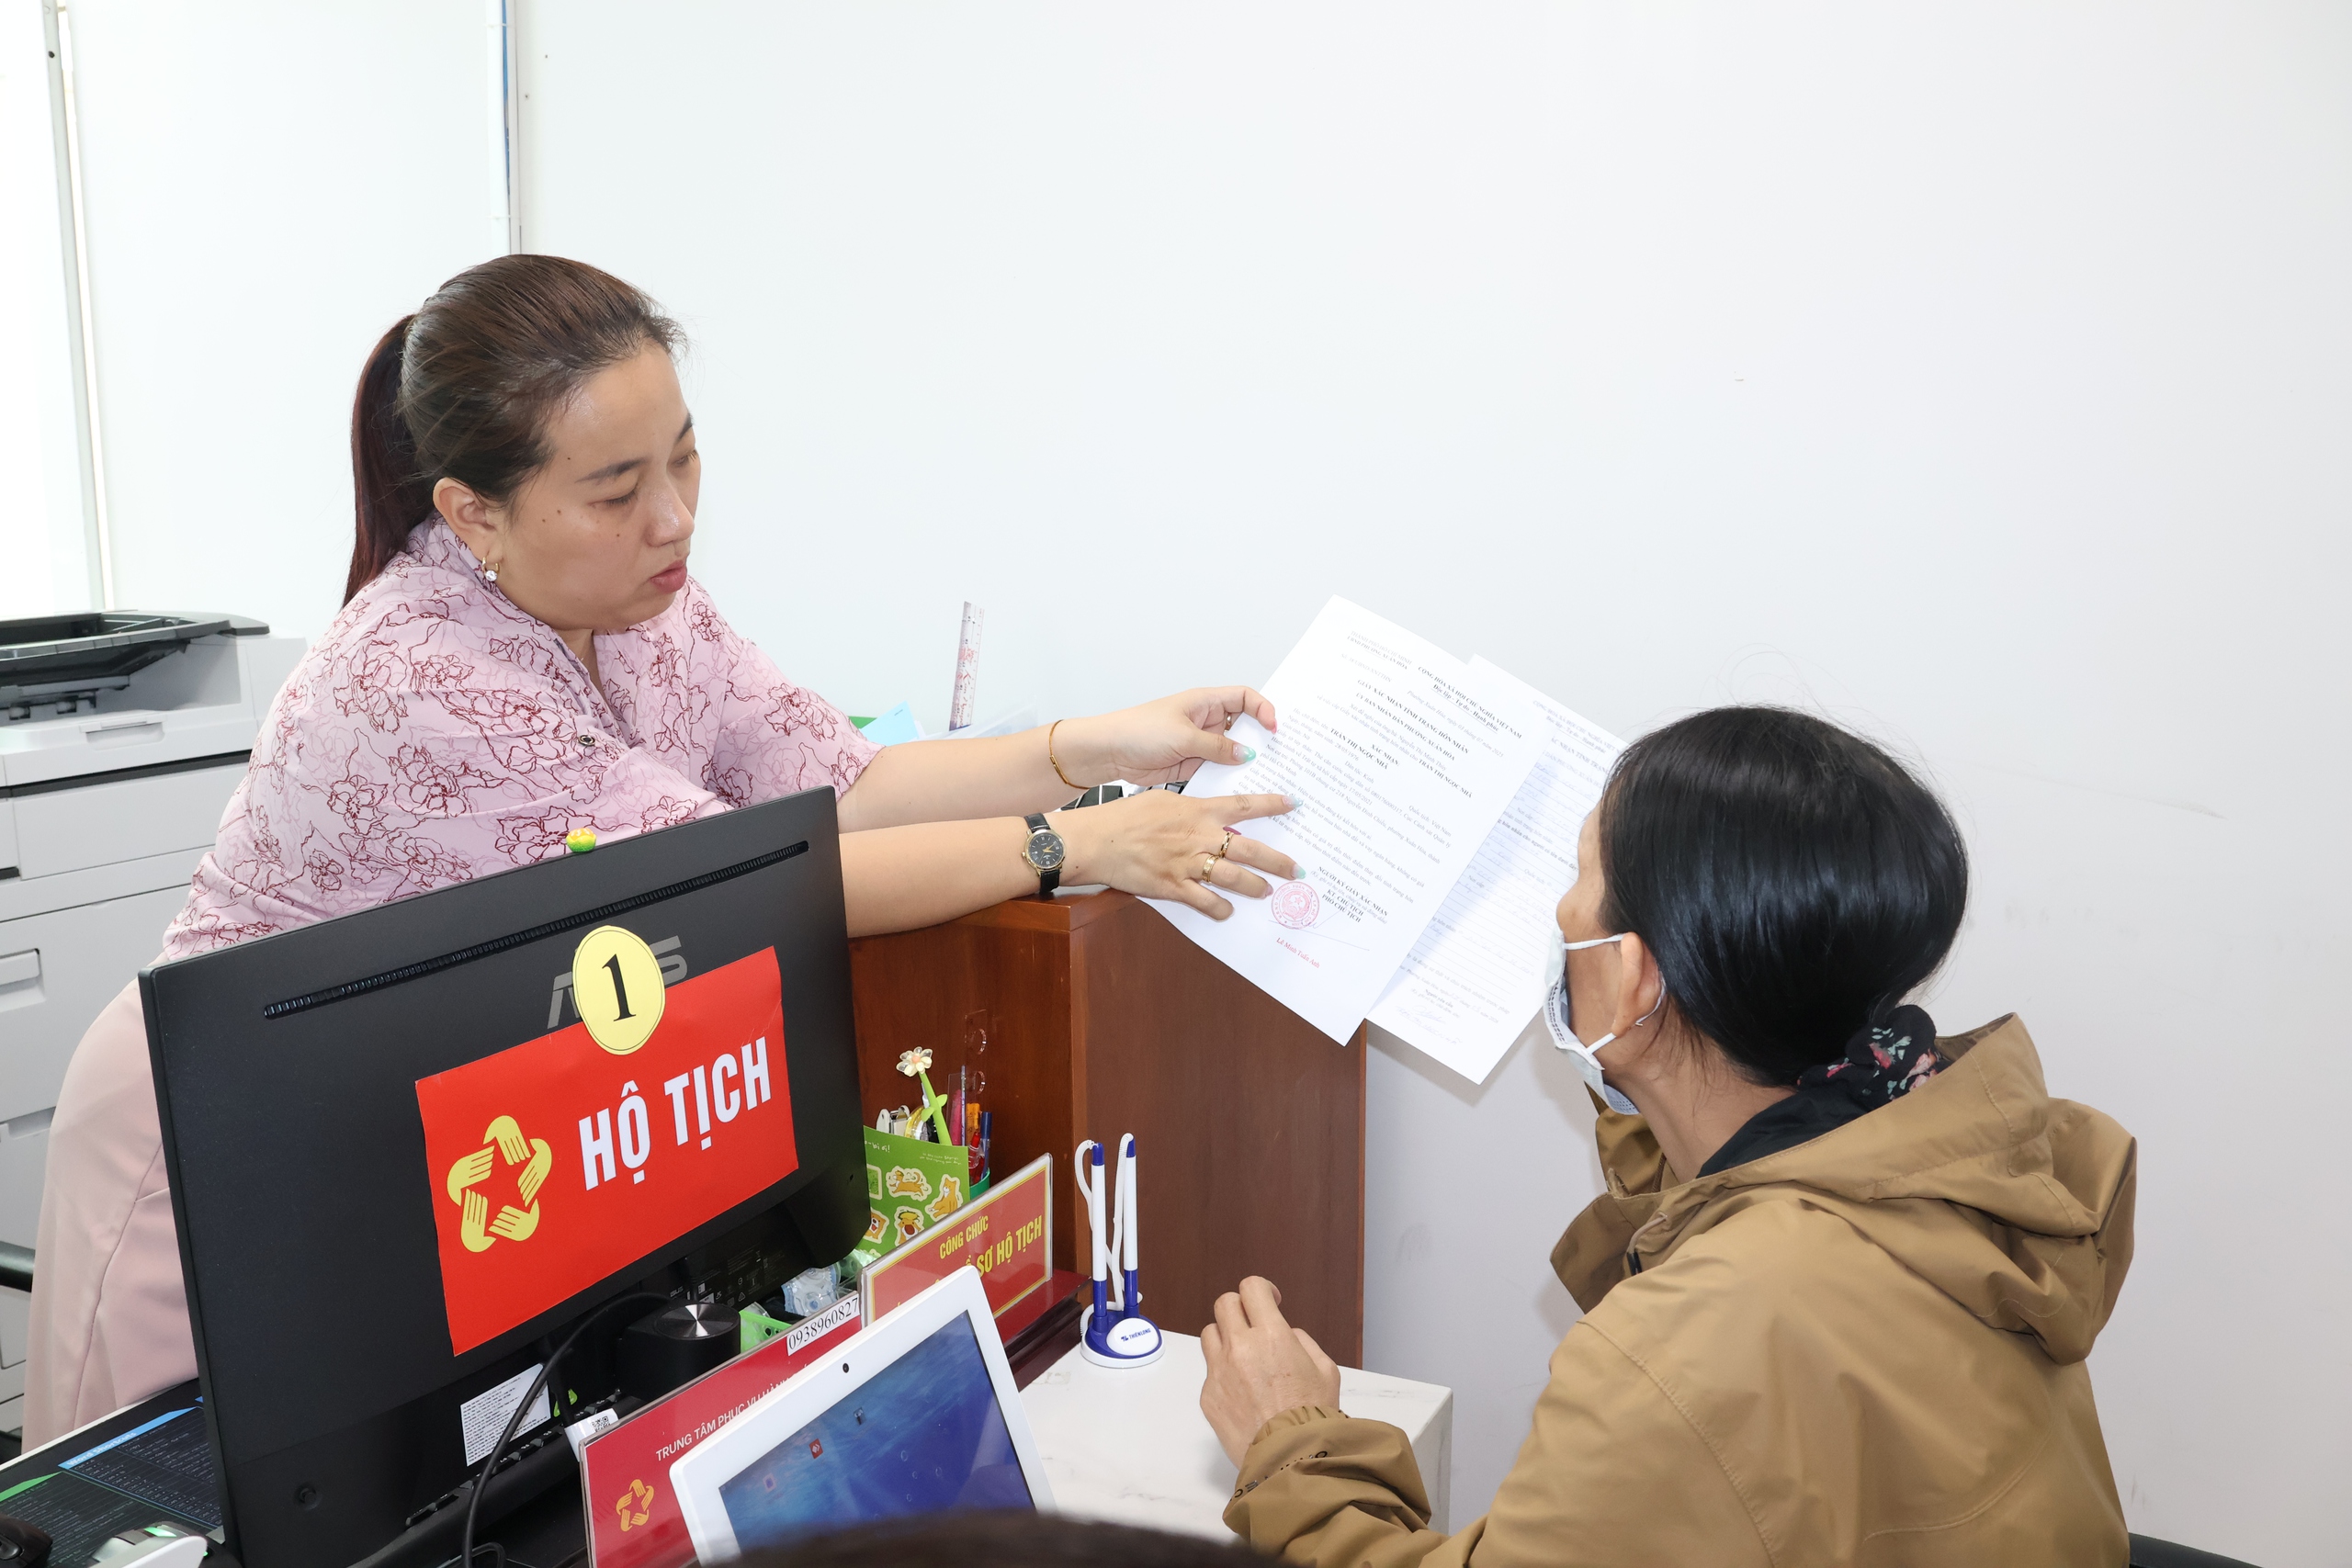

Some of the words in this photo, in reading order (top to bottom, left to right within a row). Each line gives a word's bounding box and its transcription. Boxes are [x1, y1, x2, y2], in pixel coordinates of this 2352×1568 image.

[1374, 687, 1385, 697] XÁC
[1386, 695, 1402, 709] NHẬN
[1403, 706, 1419, 719] TÌNH
[1418, 716, 1438, 734] TRẠNG
[1438, 730, 1452, 742] HÔN
[1453, 739, 1468, 754] NHÂN
[1418, 666, 1434, 679] CỘNG
[1433, 676, 1446, 687] HÒA
[1447, 684, 1455, 694] XÃ
[1454, 690, 1467, 700] HỘI
[1465, 697, 1477, 707] CHỦ
[1478, 705, 1496, 721] NGHĨA
[1496, 717, 1510, 730] VIỆT
[1508, 727, 1522, 739] NAM
[1432, 683, 1443, 694] Độc
[1442, 690, 1453, 700] lập
[1455, 698, 1464, 707] Tự
[1462, 704, 1470, 712] do
[1472, 710, 1487, 723] Hạnh
[1485, 721, 1499, 732] phúc
[1330, 728, 1346, 741] TRẦN
[1347, 739, 1359, 750] THỊ
[1359, 746, 1374, 760] NGỌC
[1363, 697, 1376, 707] BAN
[1377, 705, 1392, 717] NHÂN
[1391, 715, 1404, 726] DÂN
[1403, 723, 1427, 742] PHƯỜNG
[1428, 739, 1442, 752] XUÂN
[1442, 750, 1455, 761] HÒA
[1370, 743, 1384, 754] XÁC
[1433, 769, 1445, 780] THỊ
[1444, 775, 1459, 789] NGỌC
[1318, 866, 1338, 882] NGƯỜI
[1336, 878, 1345, 887] KÝ
[1345, 885, 1359, 897] GIẤY
[1359, 894, 1371, 906] XÁC
[1371, 902, 1387, 917] NHẬN
[1321, 893, 1335, 905] PHÓ
[1333, 902, 1348, 913] CHỦ
[1346, 910, 1362, 923] TỊCH
[1336, 896, 1349, 908] CHỦ
[1350, 903, 1364, 917] TỊCH
[1275, 937, 1285, 945] Lê
[1283, 942, 1297, 954] Minh
[1296, 949, 1310, 962] Tuấn
[1308, 958, 1320, 969] Anh
[602, 953, 637, 1022] 1
[578, 1080, 650, 1190] HỘ
[663, 1036, 772, 1151] TỊCH
[939, 1231, 964, 1259] CÔNG
[966, 1215, 989, 1243] CHỨC
[976, 1245, 993, 1278] SƠ
[996, 1231, 1013, 1266] HỘ
[1015, 1214, 1042, 1253] TỊCH
[788, 1297, 859, 1350] 0938960827
[66, 1453, 92, 1466] Word
[93, 1432, 137, 1455] Shortcuts
[655, 1433, 693, 1461] TRUNG
[694, 1419, 717, 1440] TÂM
